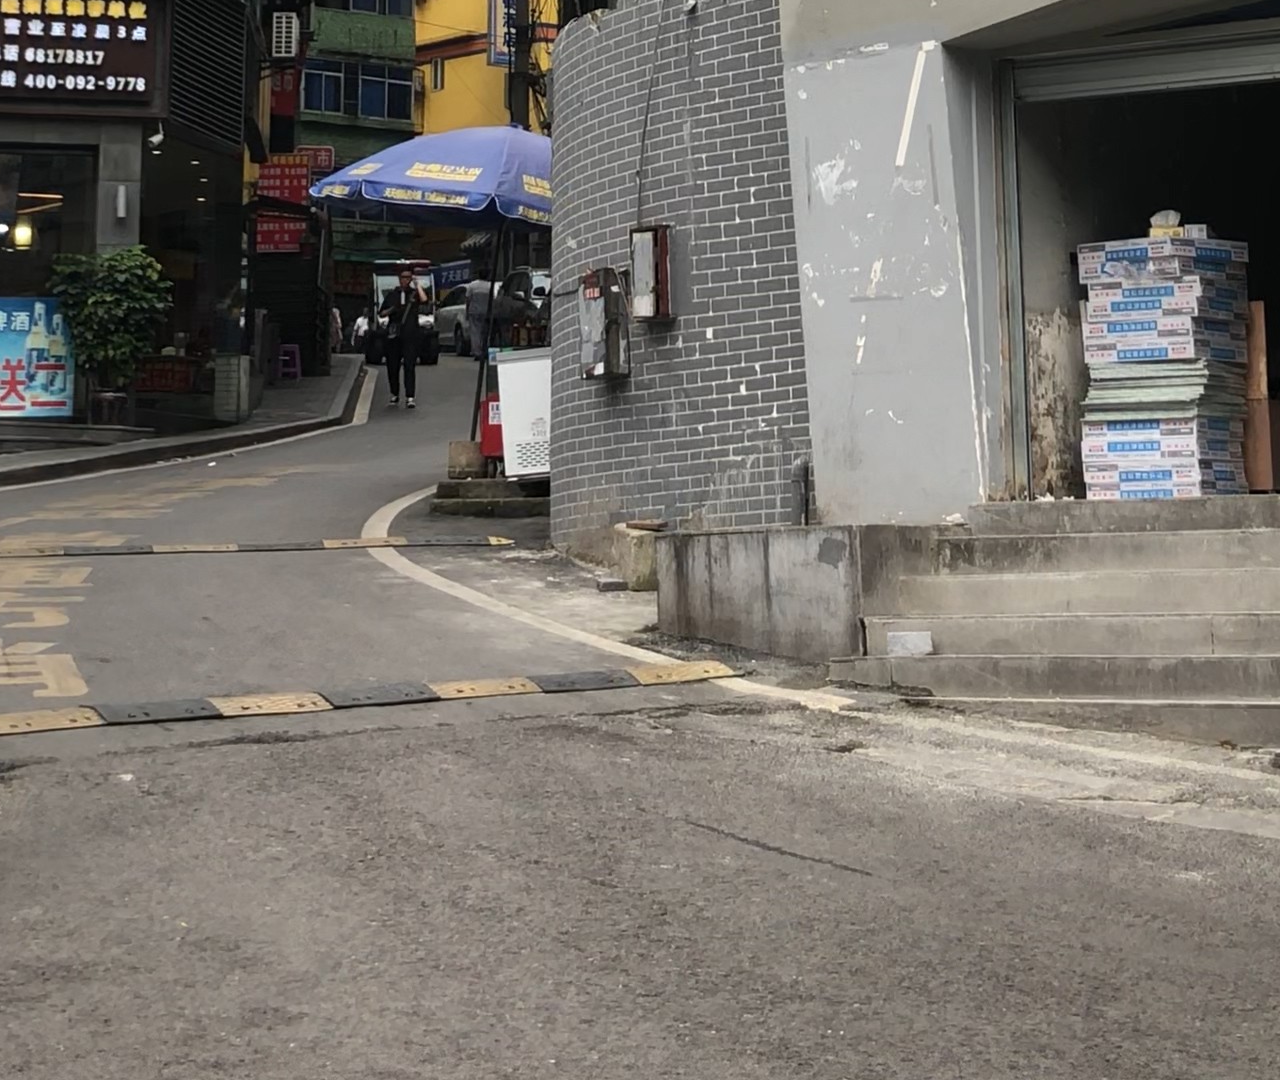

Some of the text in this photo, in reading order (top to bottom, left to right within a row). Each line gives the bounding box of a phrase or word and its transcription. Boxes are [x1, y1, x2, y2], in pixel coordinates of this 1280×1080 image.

[3, 17, 148, 42] 营业至凌晨3点
[23, 73, 147, 92] 400-092-9778
